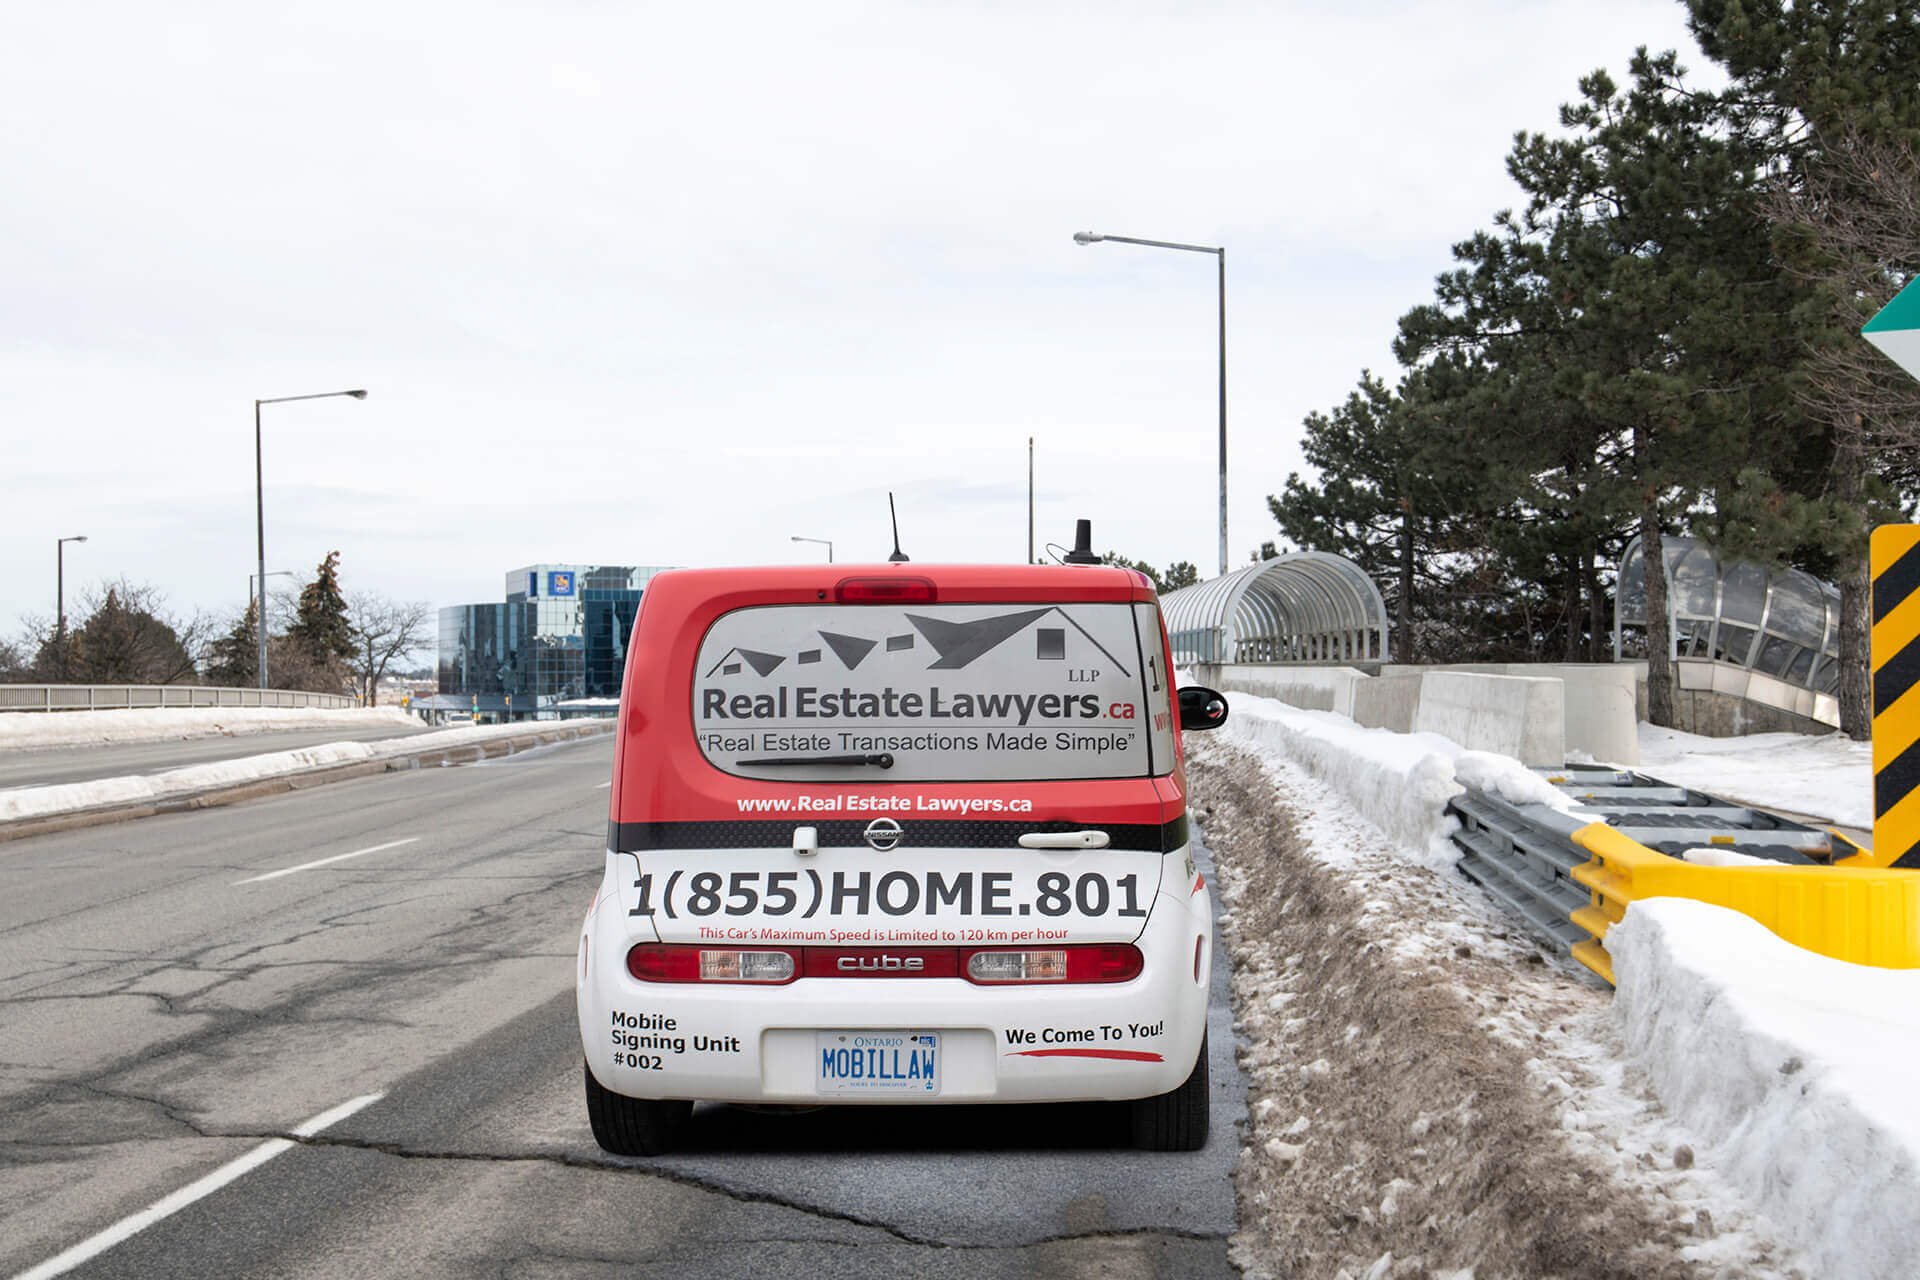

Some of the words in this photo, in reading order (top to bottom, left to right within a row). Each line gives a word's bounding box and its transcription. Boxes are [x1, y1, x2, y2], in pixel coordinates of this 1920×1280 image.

[1068, 669, 1100, 682] LLP
[763, 733, 831, 751] Estate
[838, 732, 978, 751] Transactions
[987, 733, 1047, 751] Made
[846, 795, 911, 811] Estate
[917, 795, 1032, 815] Lawyers.ca
[866, 831, 900, 839] NISSAN
[628, 870, 1147, 919] 1(855)HOME.801
[699, 927, 724, 939] This
[760, 928, 826, 941] Maximum
[830, 928, 871, 943] Speed
[874, 929, 885, 941] is
[888, 929, 938, 941] Limited
[942, 930, 956, 941] to
[960, 929, 984, 941] 120
[987, 929, 1007, 941] km
[1011, 929, 1033, 943] per
[1037, 928, 1068, 940] hour
[837, 953, 924, 971] cube
[1006, 1029, 1036, 1044] We
[1042, 1028, 1095, 1043] Come
[1100, 1025, 1122, 1040] To
[1128, 1020, 1164, 1038] You!
[612, 1030, 686, 1053] Signing
[694, 1035, 740, 1052] Unit
[854, 1036, 903, 1047] ONTARIO
[614, 1052, 663, 1070] #002
[823, 1048, 935, 1079] MOBILLAW
